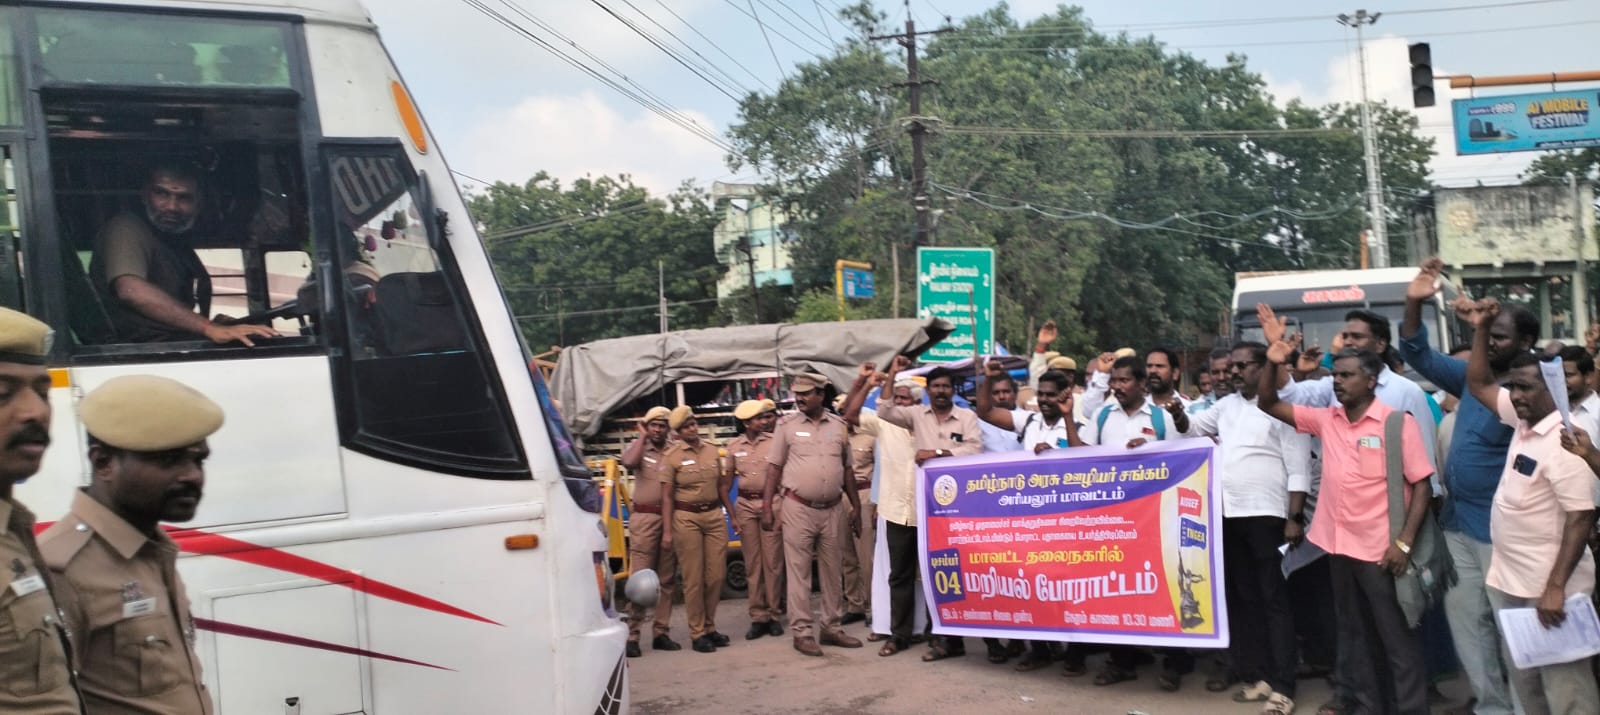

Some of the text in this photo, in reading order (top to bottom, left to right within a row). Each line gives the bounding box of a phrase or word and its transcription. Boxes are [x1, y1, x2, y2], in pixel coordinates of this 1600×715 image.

[1543, 98, 1588, 112] MOBILE
[1532, 113, 1587, 128] FESTIVAL
[983, 273, 989, 287] 2
[984, 308, 989, 321] 1
[983, 340, 989, 353] 5
[965, 462, 1169, 494] தமிழ்நாடு அரசு ஊழியர் சங்கம்
[998, 486, 1125, 508] அரியலூர் மாவட்டம்
[931, 553, 959, 569] டிசம்பர்
[969, 545, 1124, 566] மாவட்ட தலைநகரில்
[934, 571, 962, 595] 04
[964, 560, 1159, 604] மறியல் போராட்டம்
[1122, 613, 1146, 626] 10.30
